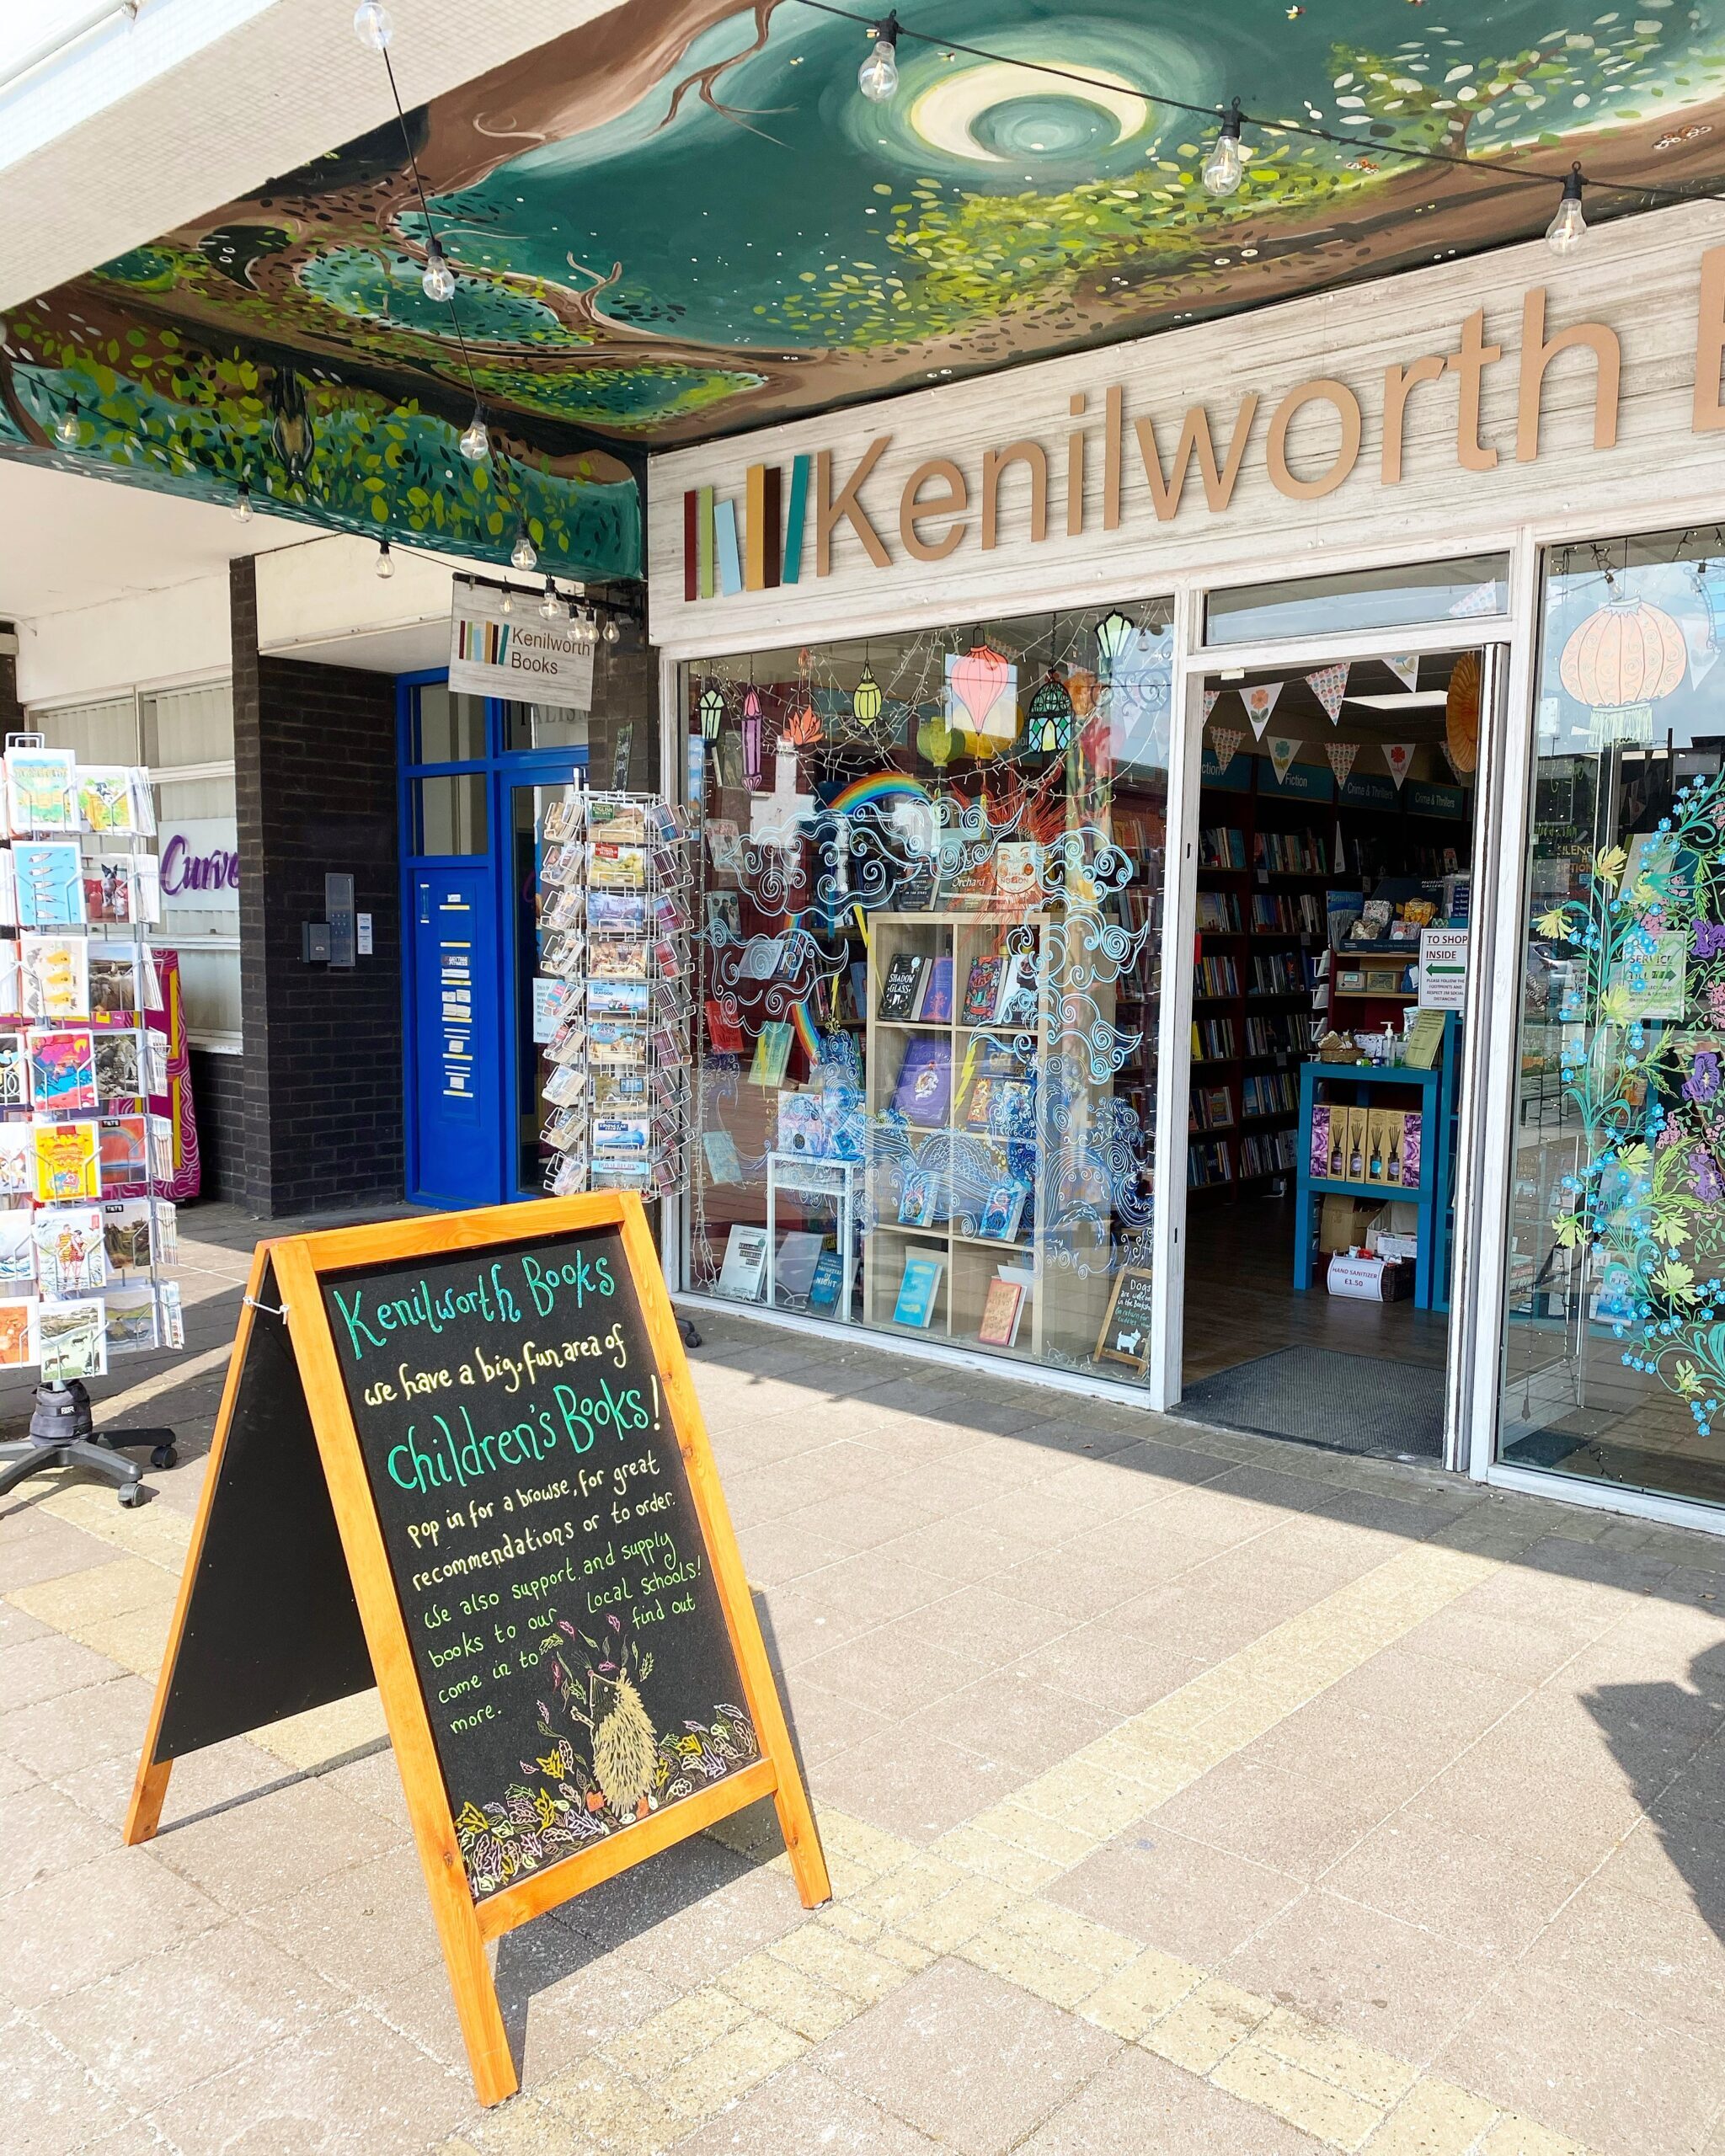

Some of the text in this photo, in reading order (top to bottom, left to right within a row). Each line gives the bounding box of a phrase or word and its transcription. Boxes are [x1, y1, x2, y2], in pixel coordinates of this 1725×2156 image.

[816, 286, 1622, 579] Kenilworth
[512, 627, 590, 656] Kenilworth
[511, 652, 558, 675] Books
[1284, 772, 1307, 787] Fiction
[1348, 782, 1365, 796] Crime
[1365, 786, 1370, 796] &
[952, 877, 985, 888] Orchard
[1427, 935, 1468, 944] TO SHOP
[1426, 950, 1457, 959] INSIDE
[889, 974, 915, 984] SHADOW
[889, 983, 910, 994] GLASS
[815, 1278, 837, 1288] NIGHT
[1344, 1278, 1364, 1287] £1.50
[1349, 1270, 1378, 1279] SANITIZER
[1130, 1279, 1151, 1296] Dogs
[334, 1250, 615, 1359] Kenilworth Books
[1124, 1298, 1133, 1307] the
[1604, 1294, 1630, 1303] TIME
[365, 1380, 398, 1406] we
[400, 1364, 452, 1401] have
[460, 1364, 475, 1385] a
[522, 1341, 563, 1385] fun
[563, 1335, 603, 1363] area
[605, 1323, 628, 1368] of
[553, 1374, 660, 1454] Books!
[446, 1510, 466, 1530] in
[468, 1502, 494, 1529] for
[503, 1497, 514, 1513] a
[515, 1479, 579, 1507] browse,
[578, 1470, 604, 1497] for
[613, 1450, 660, 1496] great
[412, 1491, 676, 1592] recommendations or to order.
[459, 1590, 499, 1618] also
[583, 1541, 616, 1574] and
[621, 1531, 677, 1572] supply
[428, 1632, 484, 1669] books
[494, 1624, 515, 1644] to
[527, 1608, 557, 1630] our
[438, 1592, 696, 1705] come in to find out
[449, 1706, 503, 1735] more.
